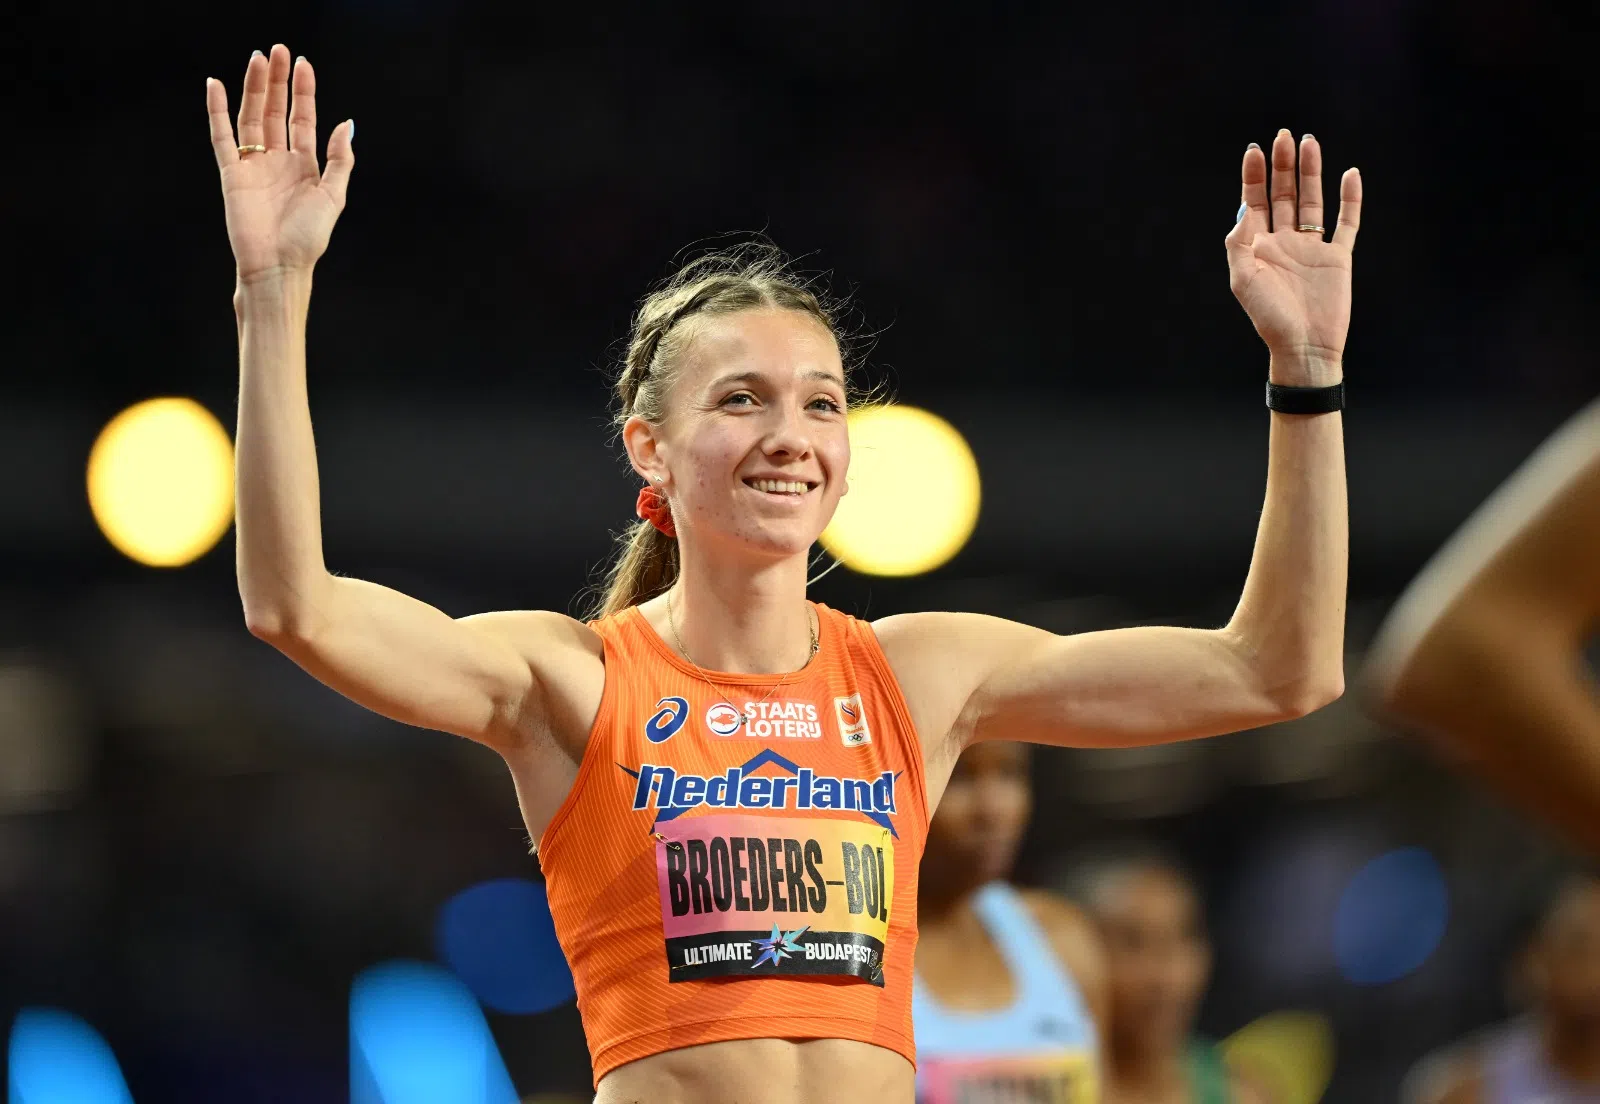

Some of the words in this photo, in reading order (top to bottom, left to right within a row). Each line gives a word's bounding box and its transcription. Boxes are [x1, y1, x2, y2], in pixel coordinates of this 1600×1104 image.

[744, 701, 818, 721] STAATS
[745, 719, 822, 738] LOTERIJ
[666, 837, 888, 923] BROEDERS-BOL
[684, 942, 753, 965] ULTIMATE
[805, 942, 872, 965] BUDAPEST
